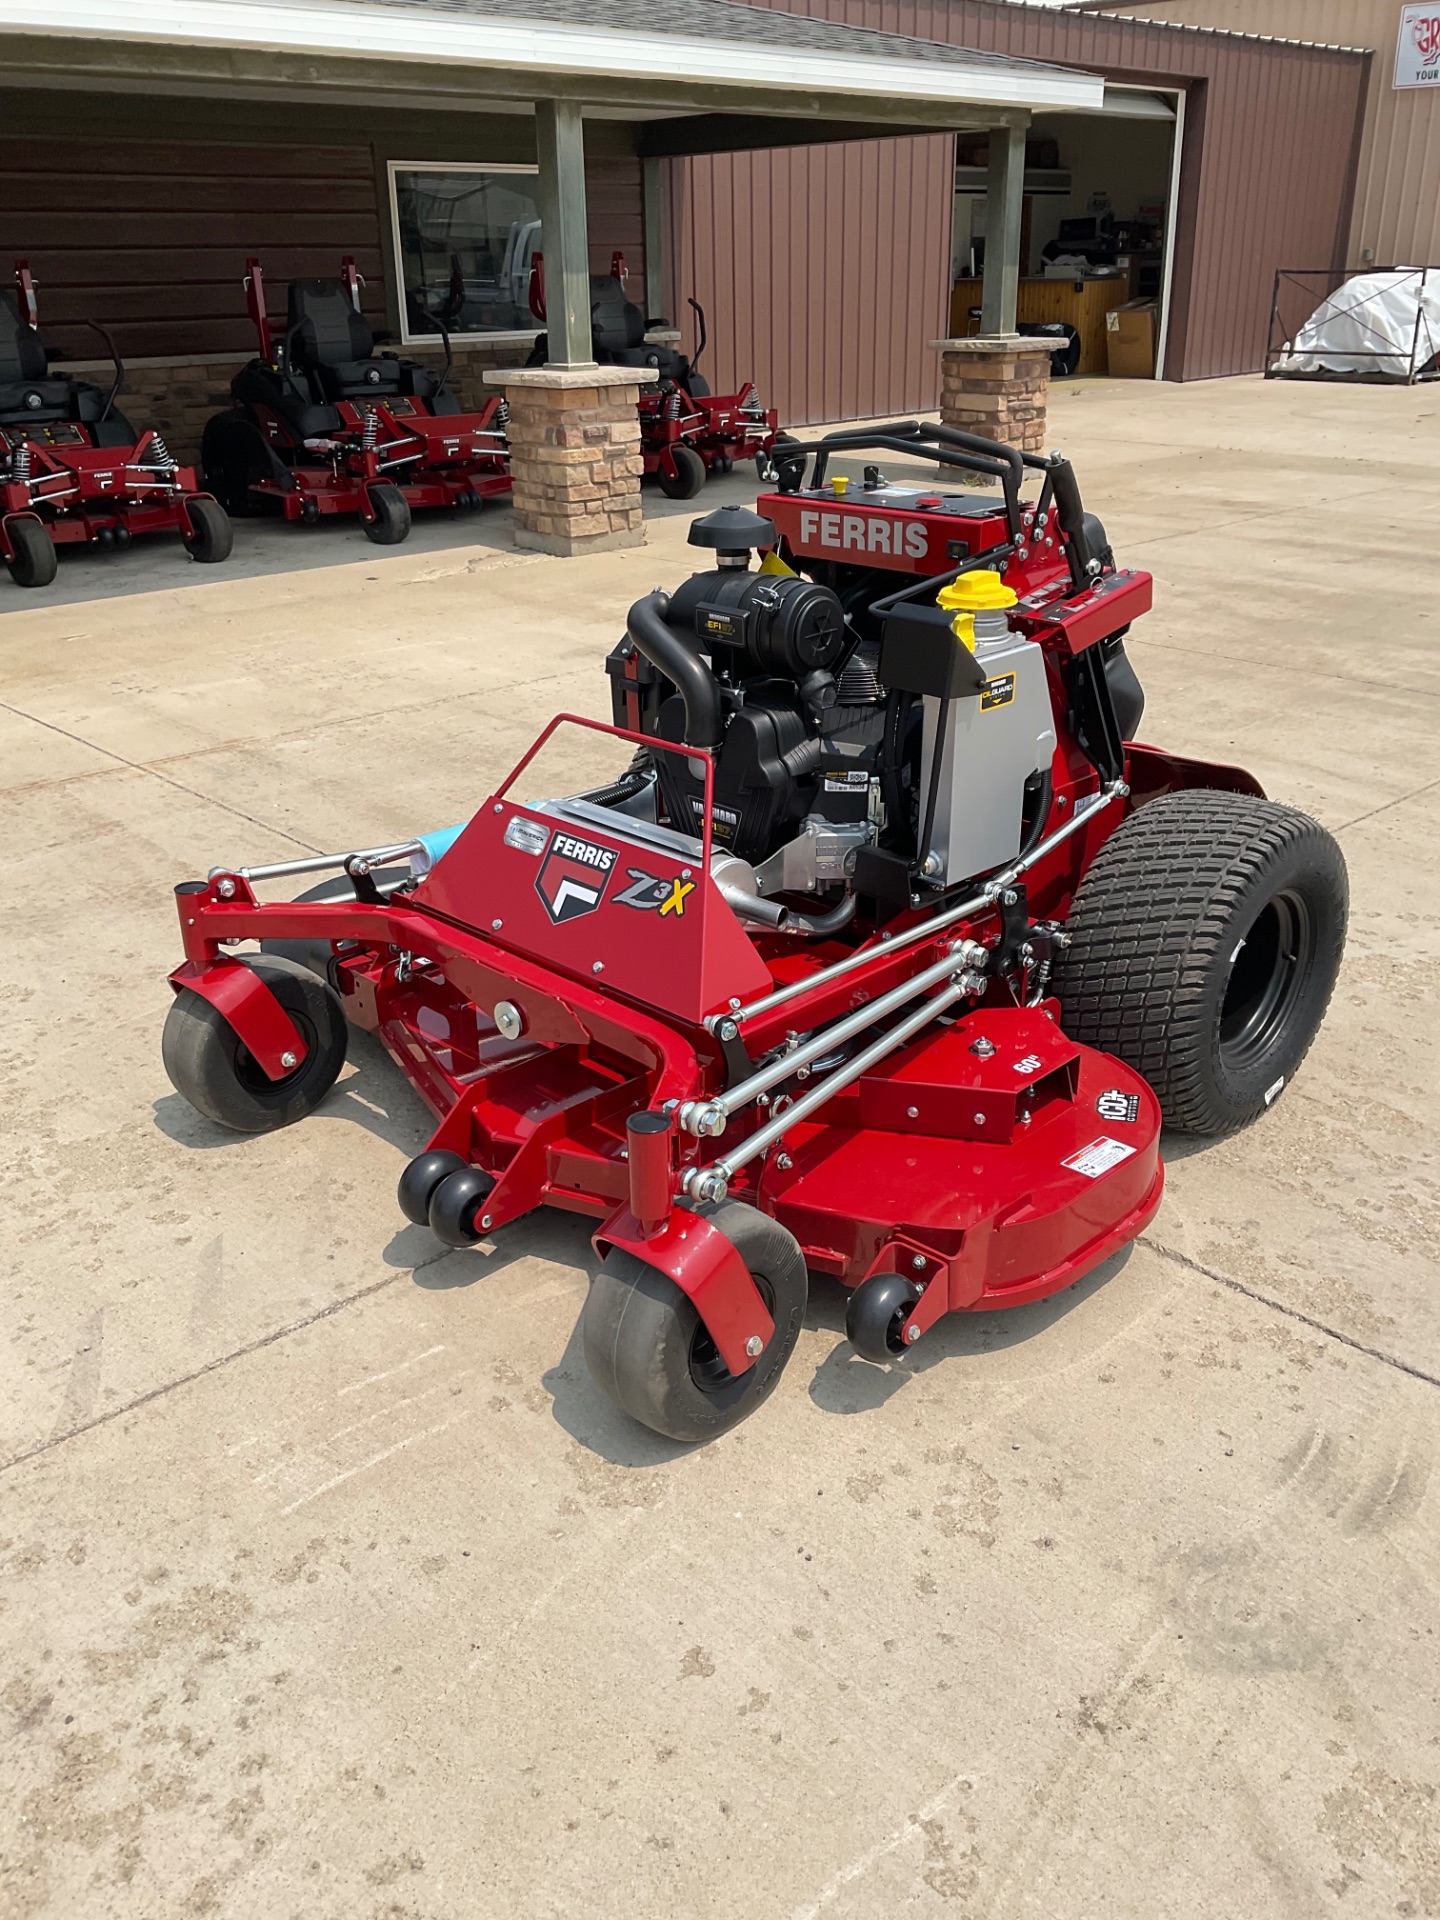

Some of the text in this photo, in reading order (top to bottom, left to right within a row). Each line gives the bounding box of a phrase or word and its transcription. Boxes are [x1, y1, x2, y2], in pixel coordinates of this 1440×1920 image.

[1415, 69, 1439, 80] YOUR
[800, 510, 929, 559] FERRIS
[553, 835, 613, 869] FERRIS
